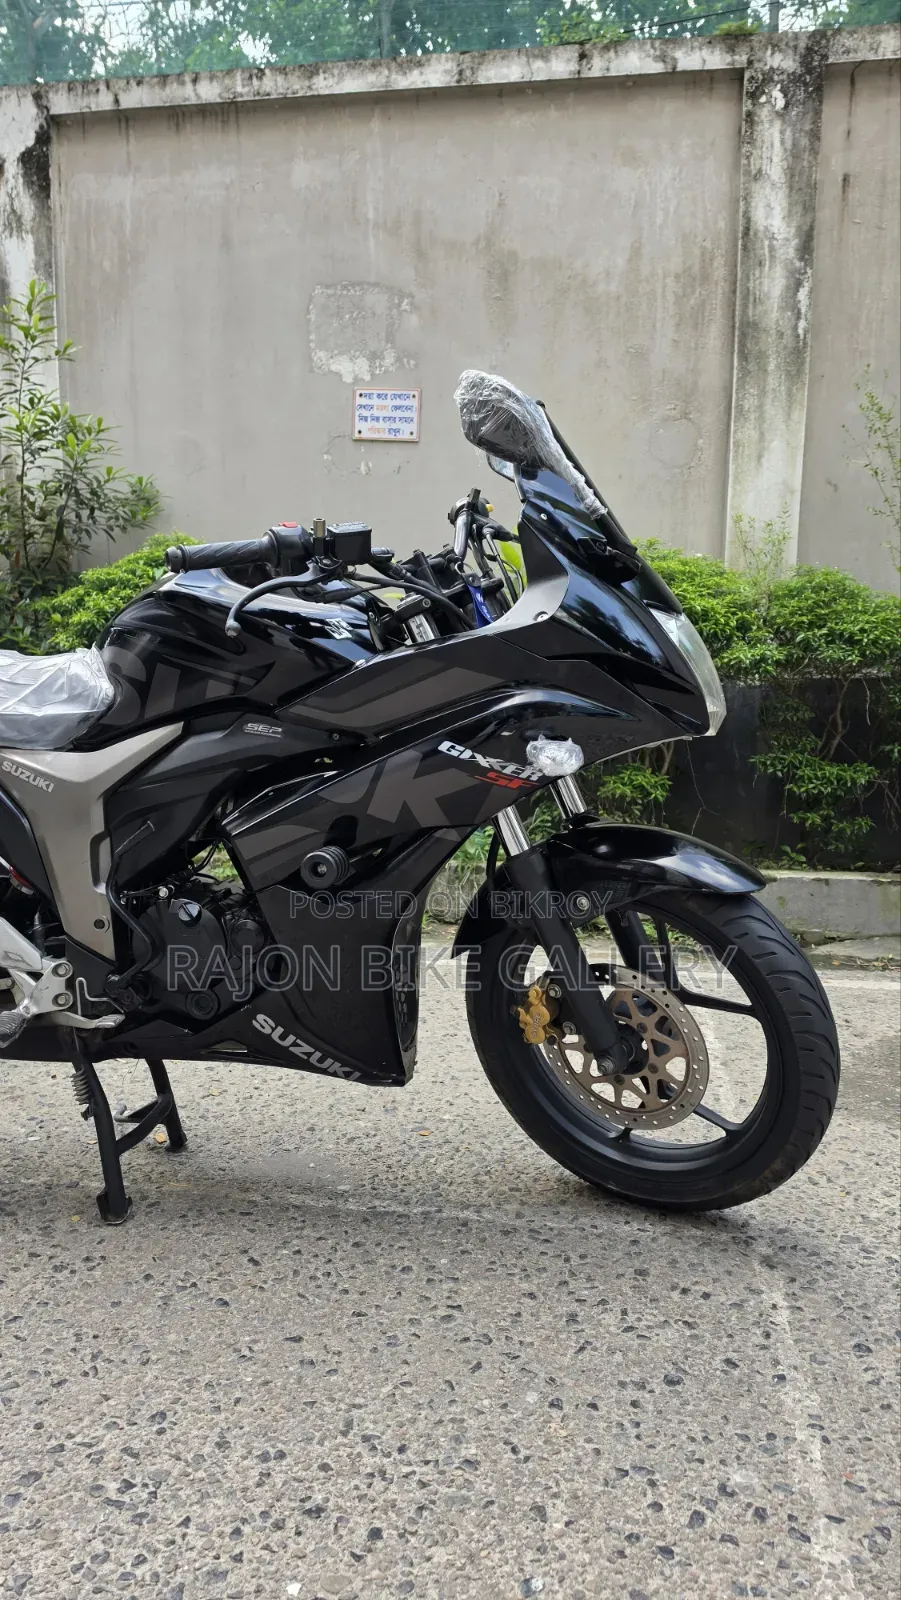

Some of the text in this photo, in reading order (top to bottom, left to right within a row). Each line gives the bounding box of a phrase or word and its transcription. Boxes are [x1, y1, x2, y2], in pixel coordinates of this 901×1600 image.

[375, 392, 388, 400] করে
[390, 393, 411, 401] যেখানে
[356, 403, 374, 412] সেখানে
[358, 412, 368, 423] নিজ
[370, 413, 380, 423] নিজ
[245, 722, 283, 733] SEP
[1, 760, 55, 793] SUZUKI
[474, 771, 541, 789] SF
[252, 1013, 362, 1080] SUZUKI
